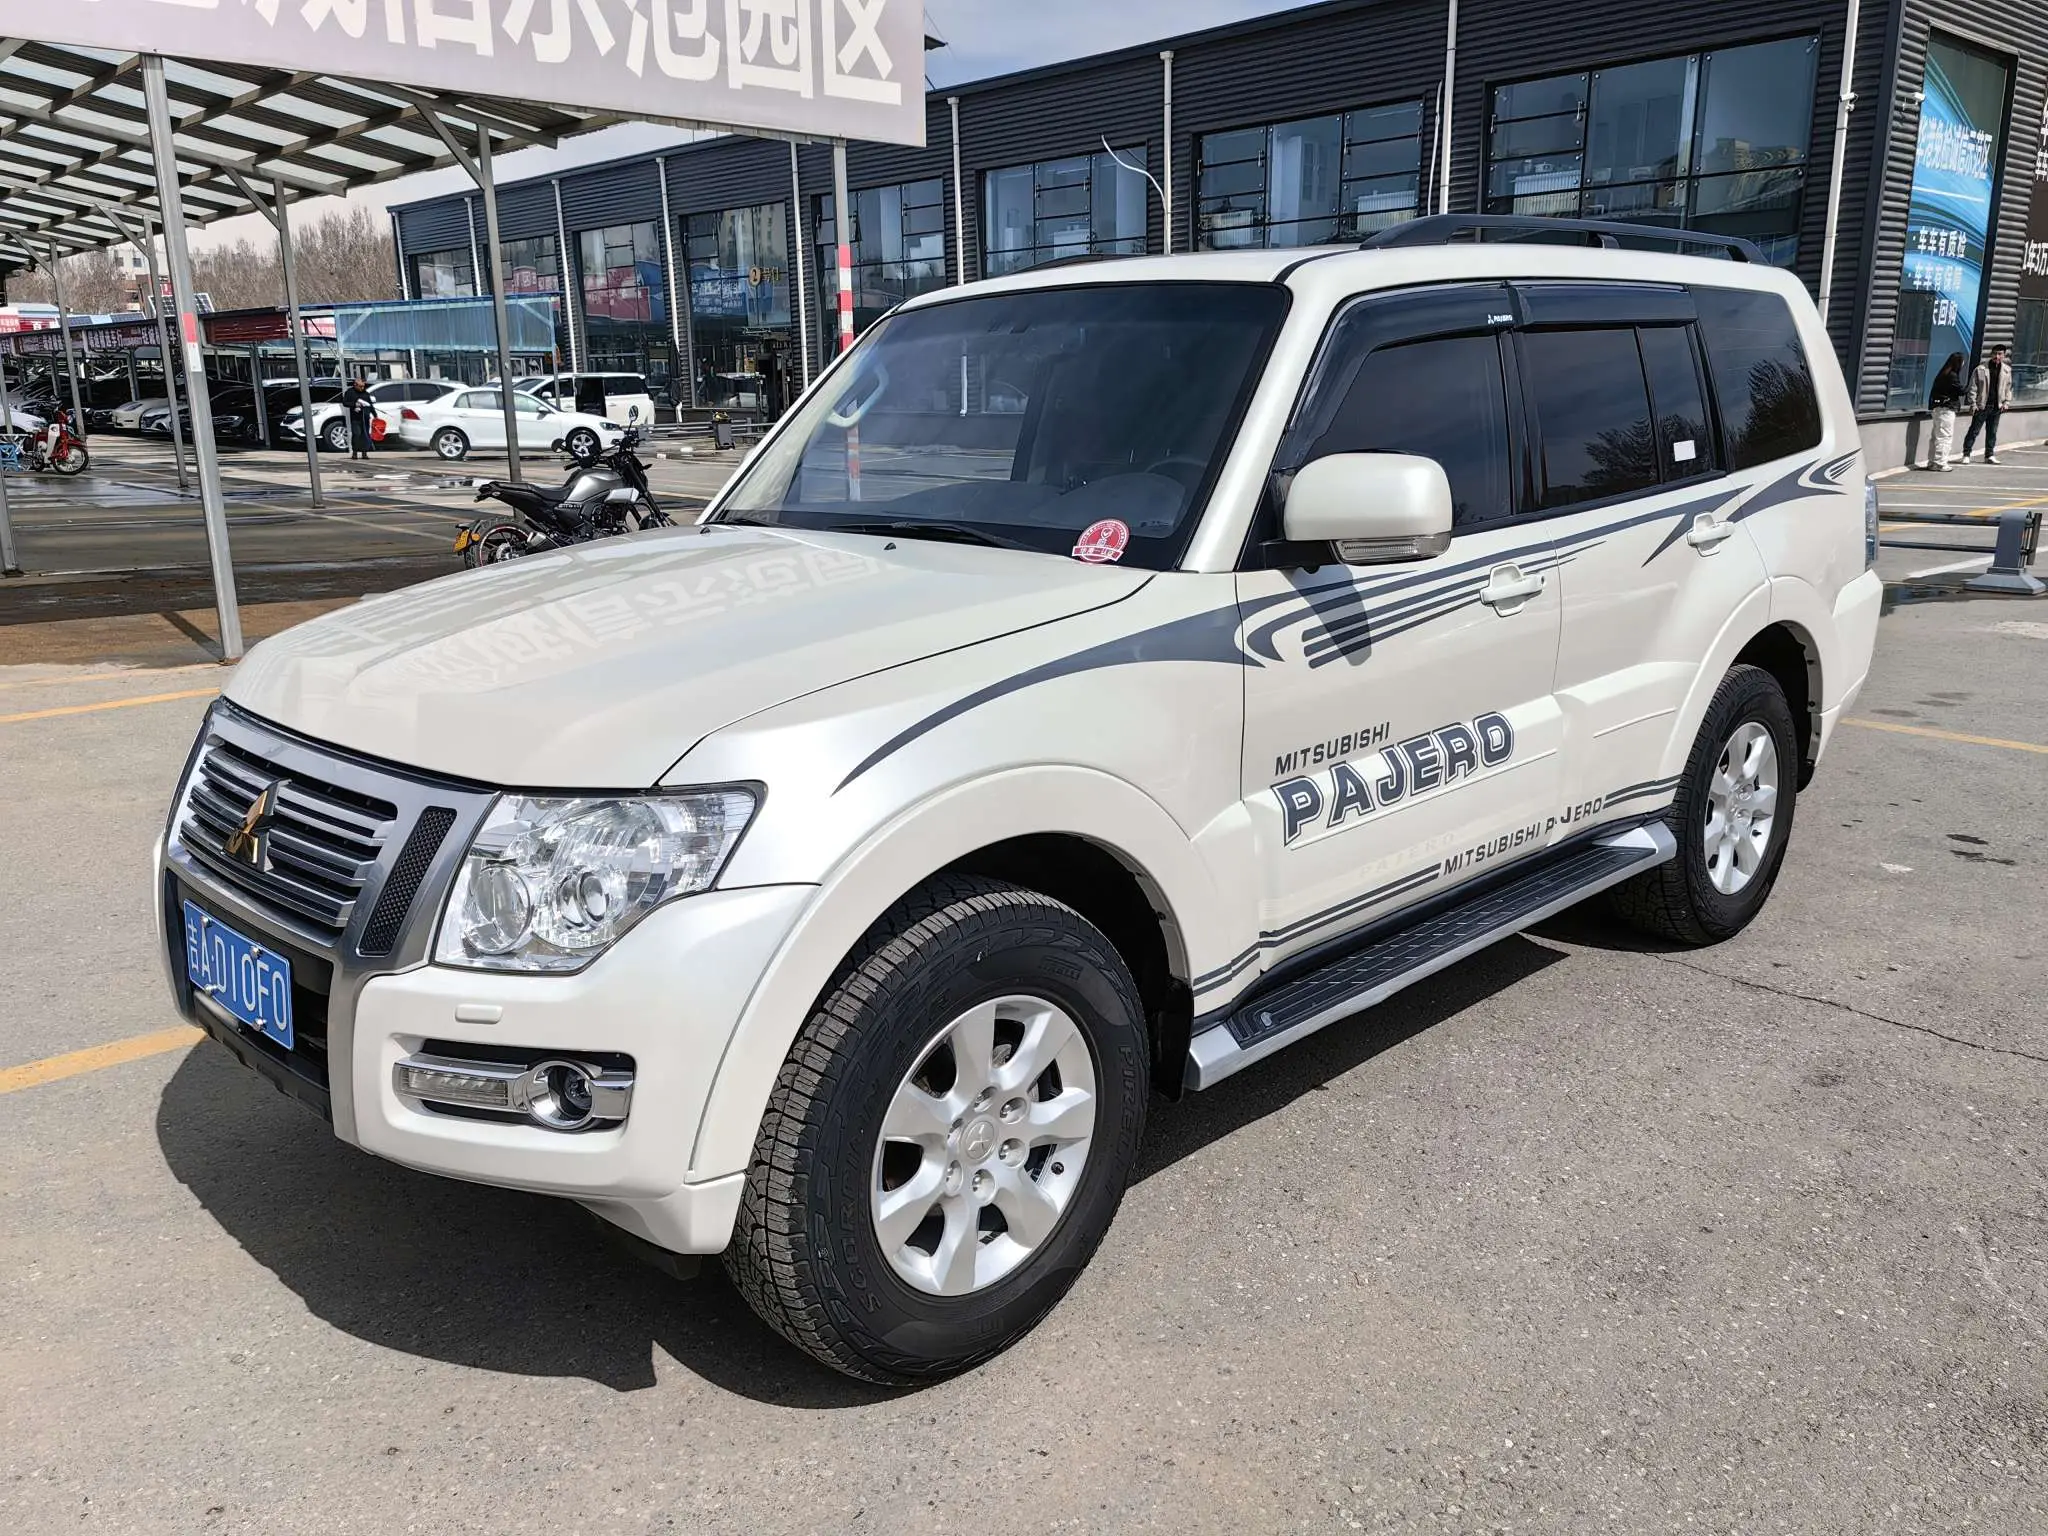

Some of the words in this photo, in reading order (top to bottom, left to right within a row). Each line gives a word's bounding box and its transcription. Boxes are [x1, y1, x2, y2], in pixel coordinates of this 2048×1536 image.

[2022, 239, 2048, 276] 1年3万
[1270, 711, 1515, 847] PAJERO
[1274, 721, 1390, 777] MITSUBISHI
[1443, 822, 1541, 876] MITSUBISHI
[1545, 797, 1603, 834] PJERO
